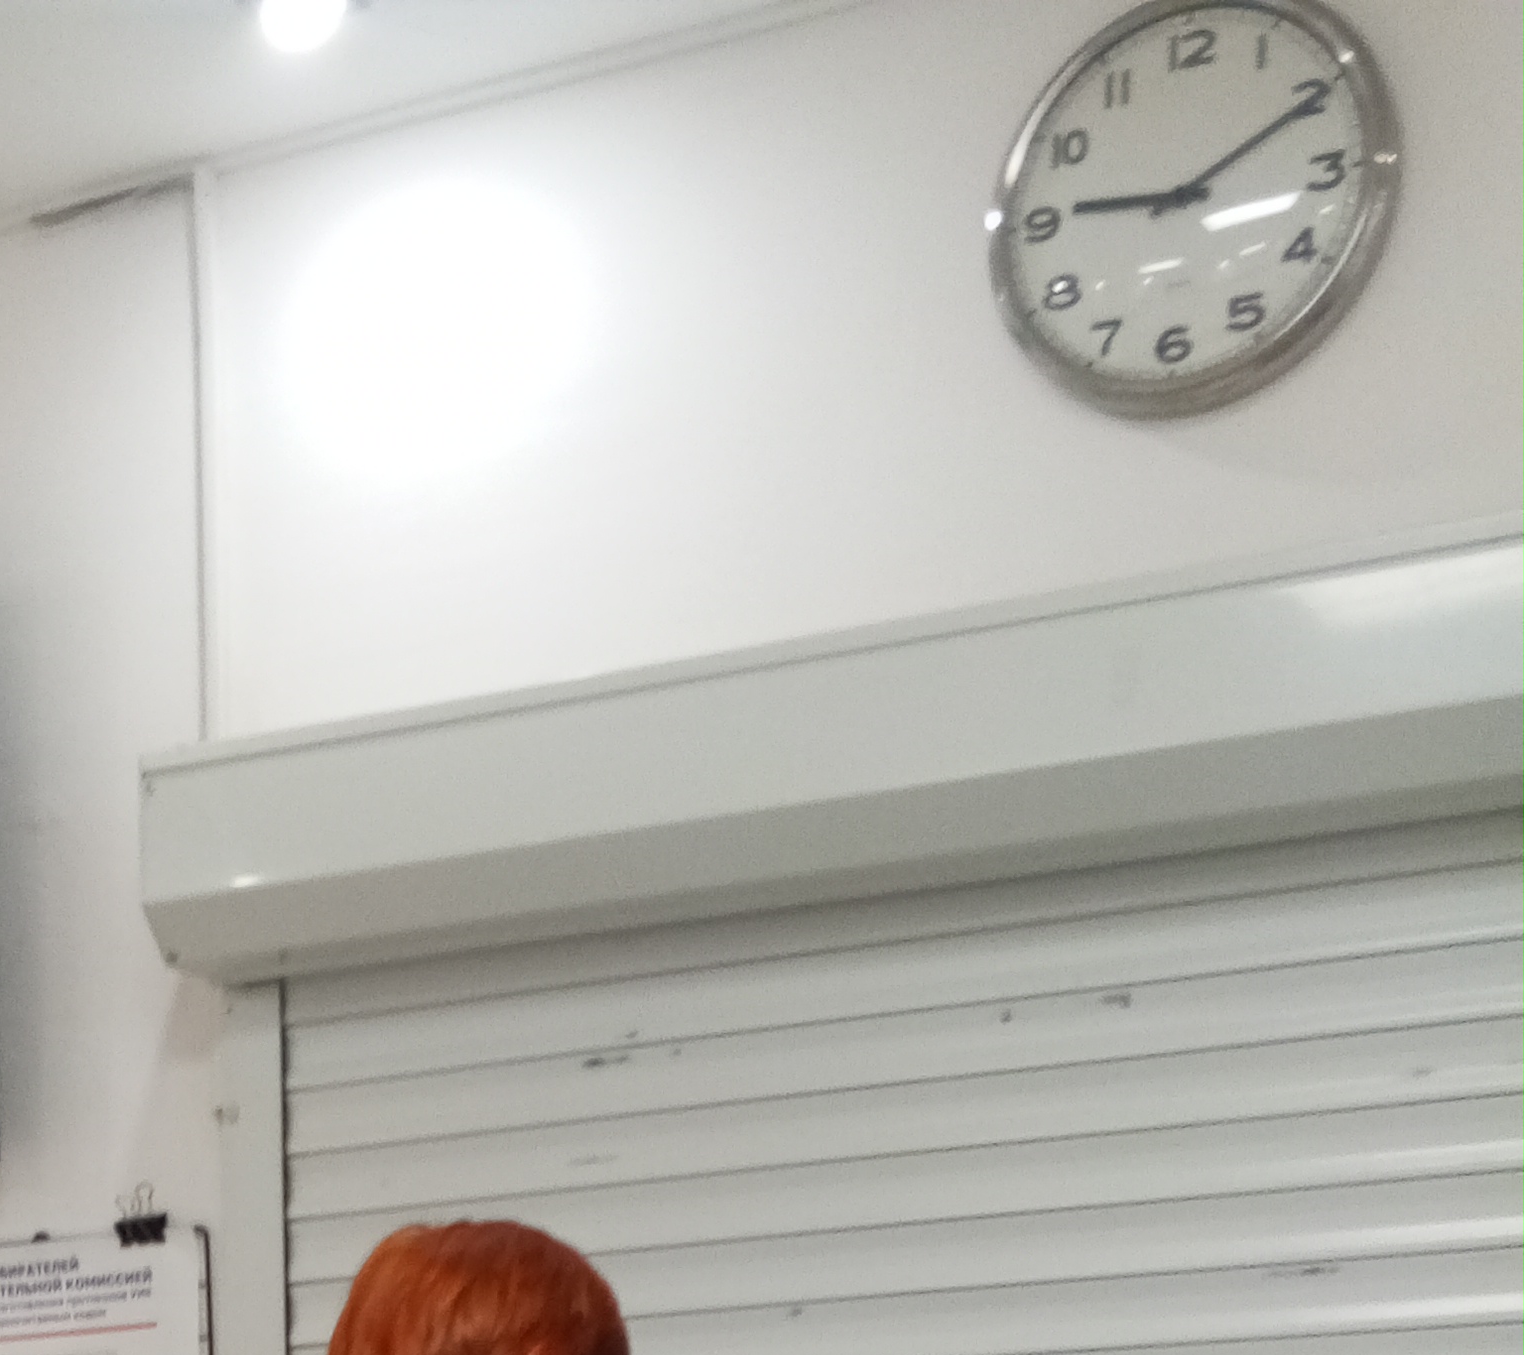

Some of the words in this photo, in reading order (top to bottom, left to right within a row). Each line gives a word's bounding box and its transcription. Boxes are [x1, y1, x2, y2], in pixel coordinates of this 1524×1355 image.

[1166, 29, 1216, 72] 12
[1255, 33, 1268, 70] 1
[1103, 68, 1132, 109] 11
[1291, 78, 1332, 116] 2
[1049, 128, 1089, 169] 10
[1306, 149, 1347, 191] 3
[1023, 206, 1061, 243] 9
[1281, 227, 1318, 263] 4
[1041, 274, 1082, 311] 8
[1226, 291, 1267, 332] 5
[1090, 319, 1123, 357] 7
[1155, 325, 1194, 364] 6
